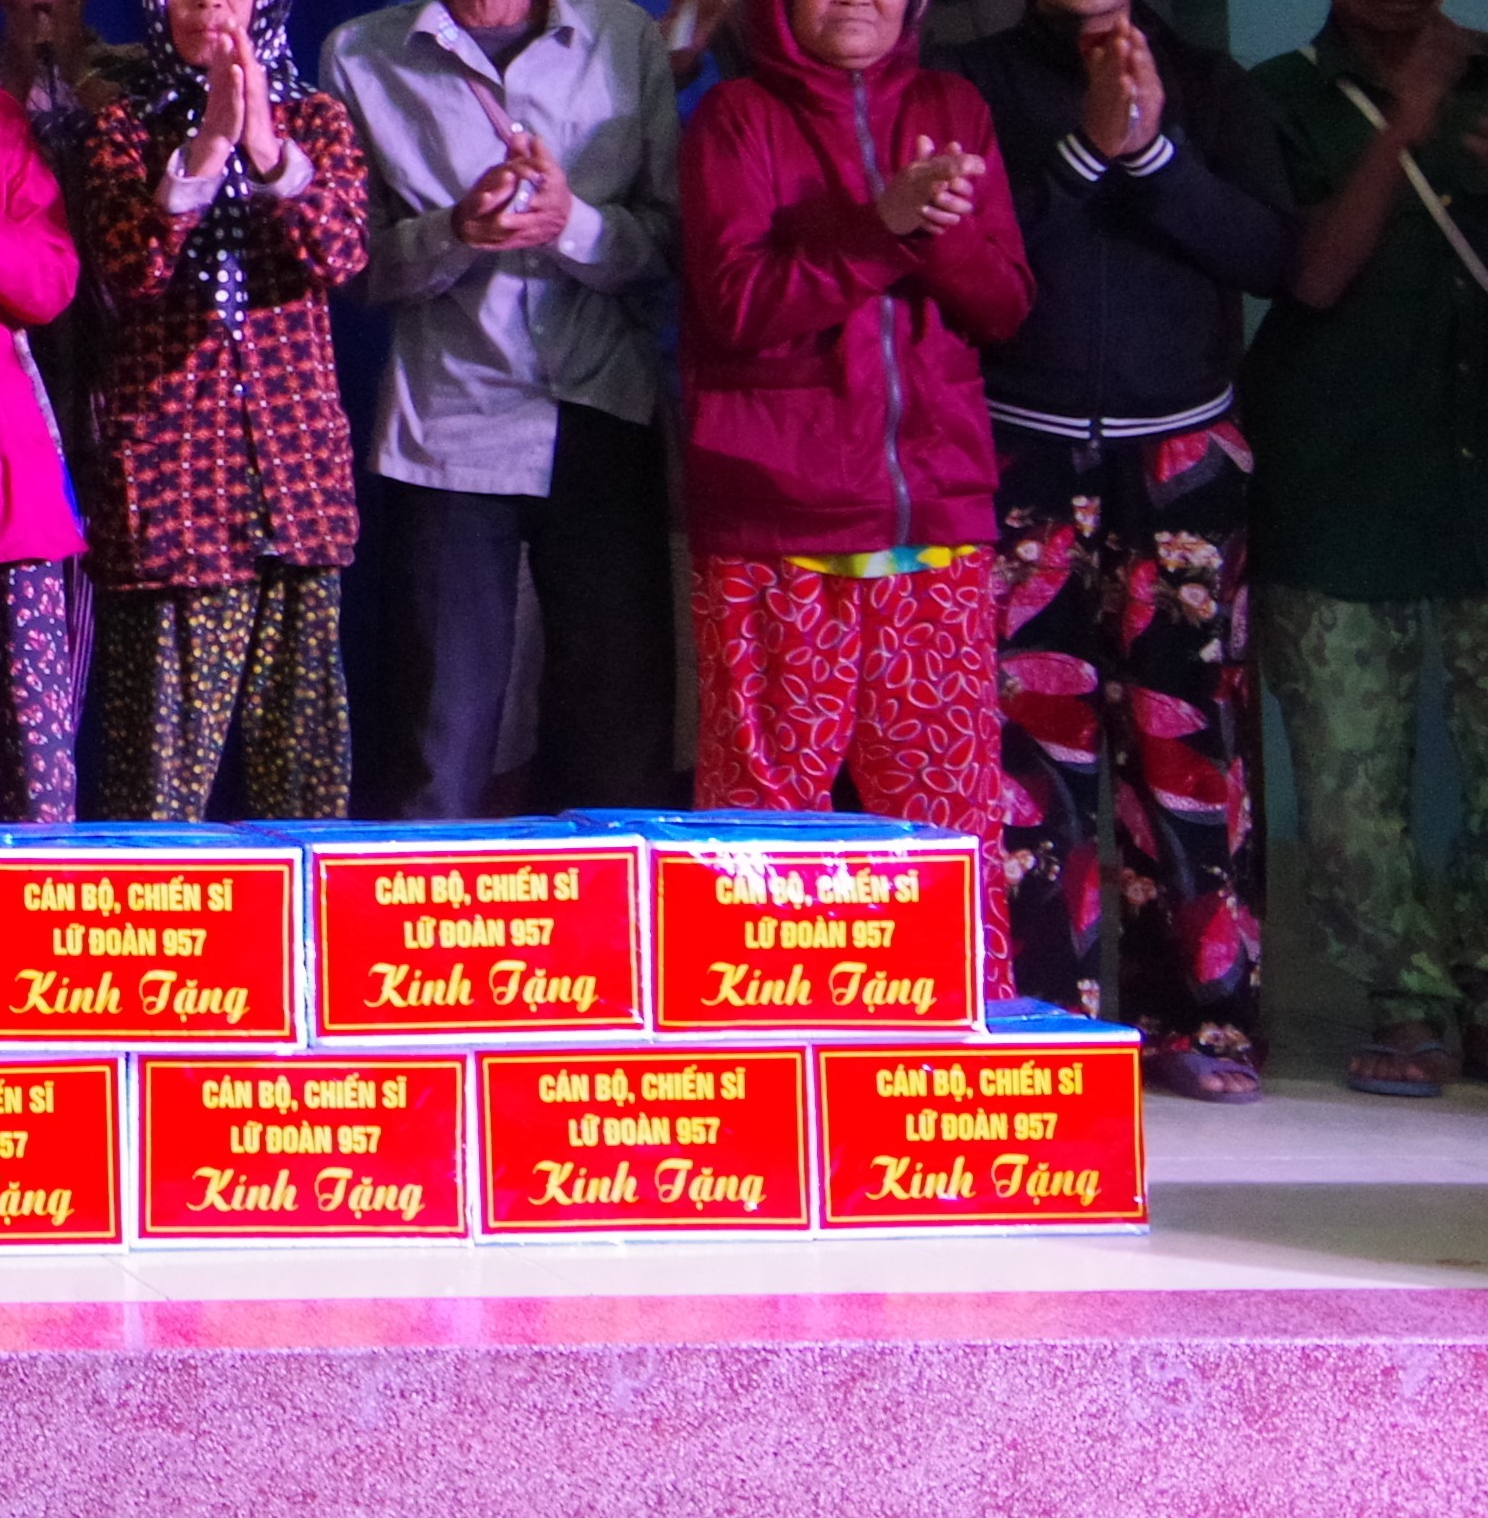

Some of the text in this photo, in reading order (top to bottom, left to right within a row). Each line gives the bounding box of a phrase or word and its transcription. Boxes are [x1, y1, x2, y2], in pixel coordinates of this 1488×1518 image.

[375, 866, 578, 908] CÁN BỘ, CHIẾN SĨ
[404, 914, 554, 948] LỮ ĐOÀN 957
[362, 960, 599, 1012] Kính Tặng
[29, 1081, 54, 1113] SĨ
[539, 1067, 745, 1106] CÁN BỘ, CHIẾN SĨ
[876, 1063, 1082, 1102] CÁN BỘ, CHIẾN SĨ
[569, 1113, 720, 1146] LỮ ĐOÀN 957
[906, 1108, 1057, 1141] LỮ ĐOÀN 957
[526, 1158, 767, 1211] Kính Tặng
[863, 1154, 1101, 1205] Kính Tặng
